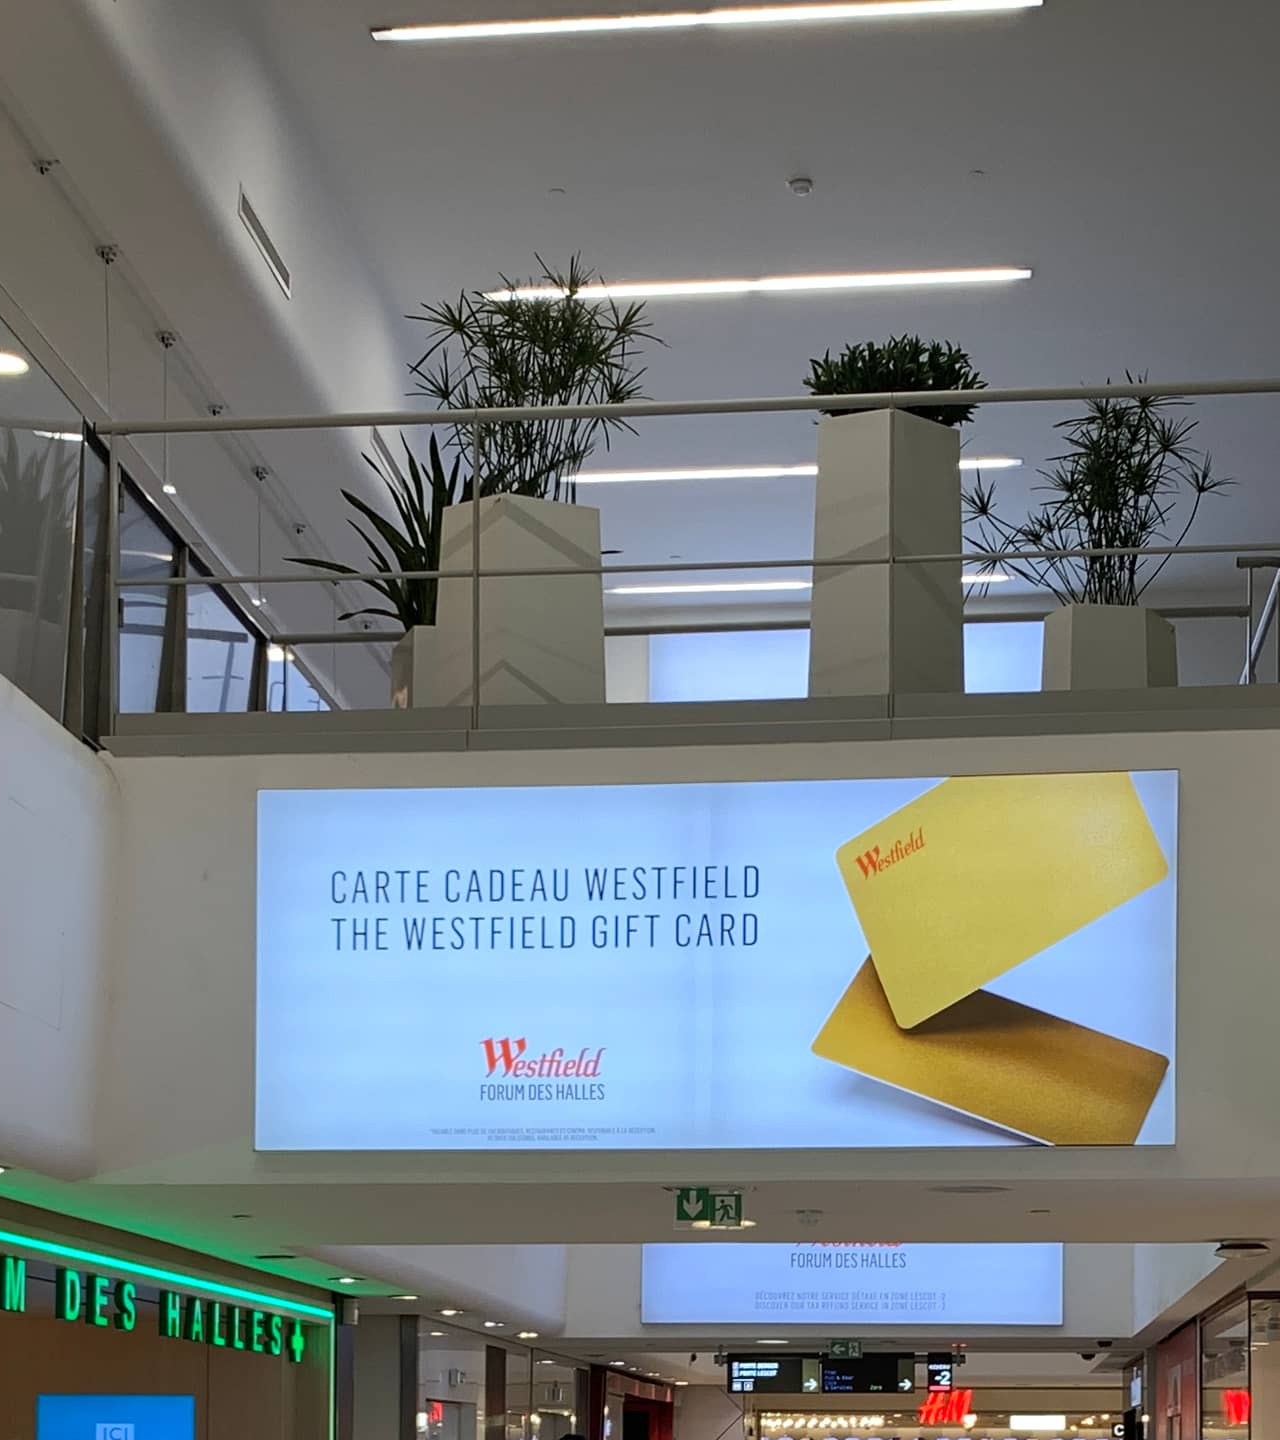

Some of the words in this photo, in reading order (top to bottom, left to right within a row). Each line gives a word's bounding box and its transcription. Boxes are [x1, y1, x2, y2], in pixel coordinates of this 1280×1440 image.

[856, 827, 925, 880] Westfield
[331, 870, 430, 904] CARTE
[445, 868, 570, 903] CADEAU
[585, 865, 761, 901] WESTFIELD
[331, 917, 389, 951] THE
[403, 915, 577, 950] WESTFIELD
[591, 914, 662, 949] GIFT
[675, 912, 759, 948] CARD
[480, 1037, 607, 1079] Westfield
[480, 1083, 526, 1102] FORUM
[528, 1083, 553, 1101] DES
[556, 1083, 605, 1101] HALLES
[790, 1252, 832, 1269] FORUM
[835, 1252, 858, 1268] DES
[861, 1252, 907, 1268] HALLES
[55, 1267, 137, 1331] DES
[159, 1290, 282, 1356] HALLES
[934, 1371, 951, 1385] -2
